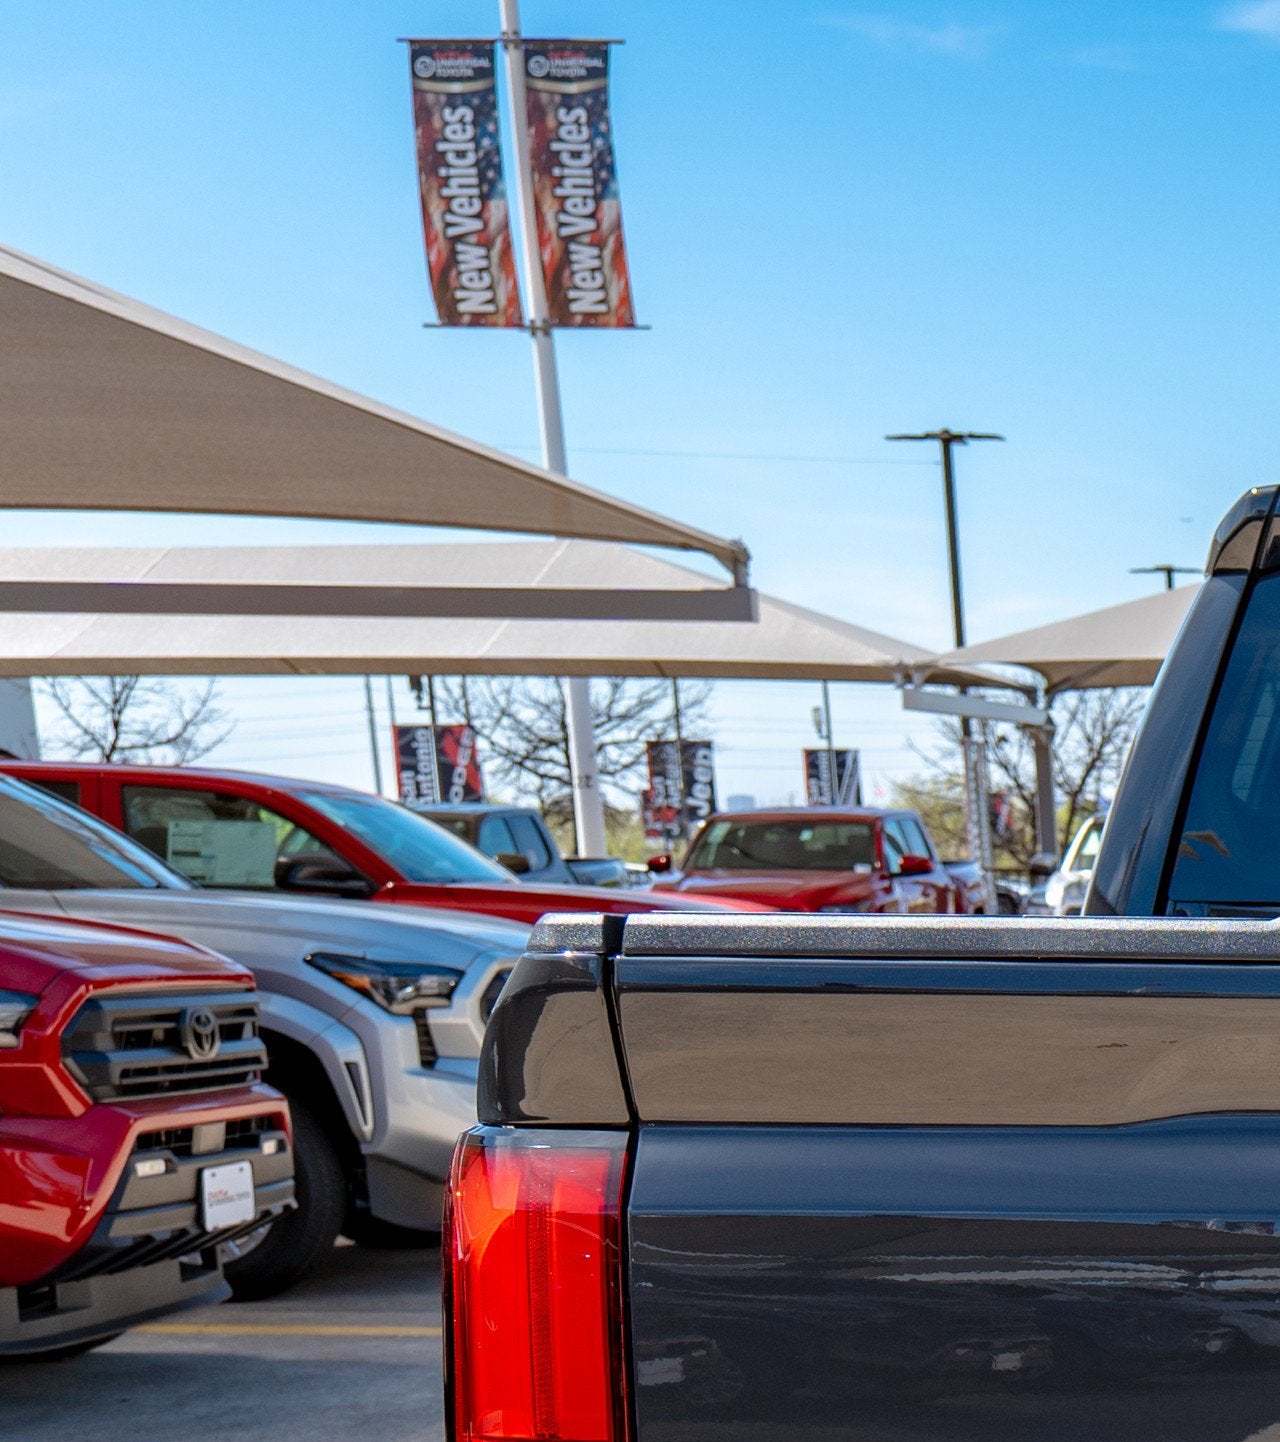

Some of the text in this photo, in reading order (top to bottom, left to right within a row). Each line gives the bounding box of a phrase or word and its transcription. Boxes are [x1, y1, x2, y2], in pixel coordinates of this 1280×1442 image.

[435, 105, 484, 238] Vehicles
[551, 106, 597, 237] Vehicles
[454, 242, 497, 313] New
[567, 242, 609, 313] New
[686, 747, 712, 817] Jeep
